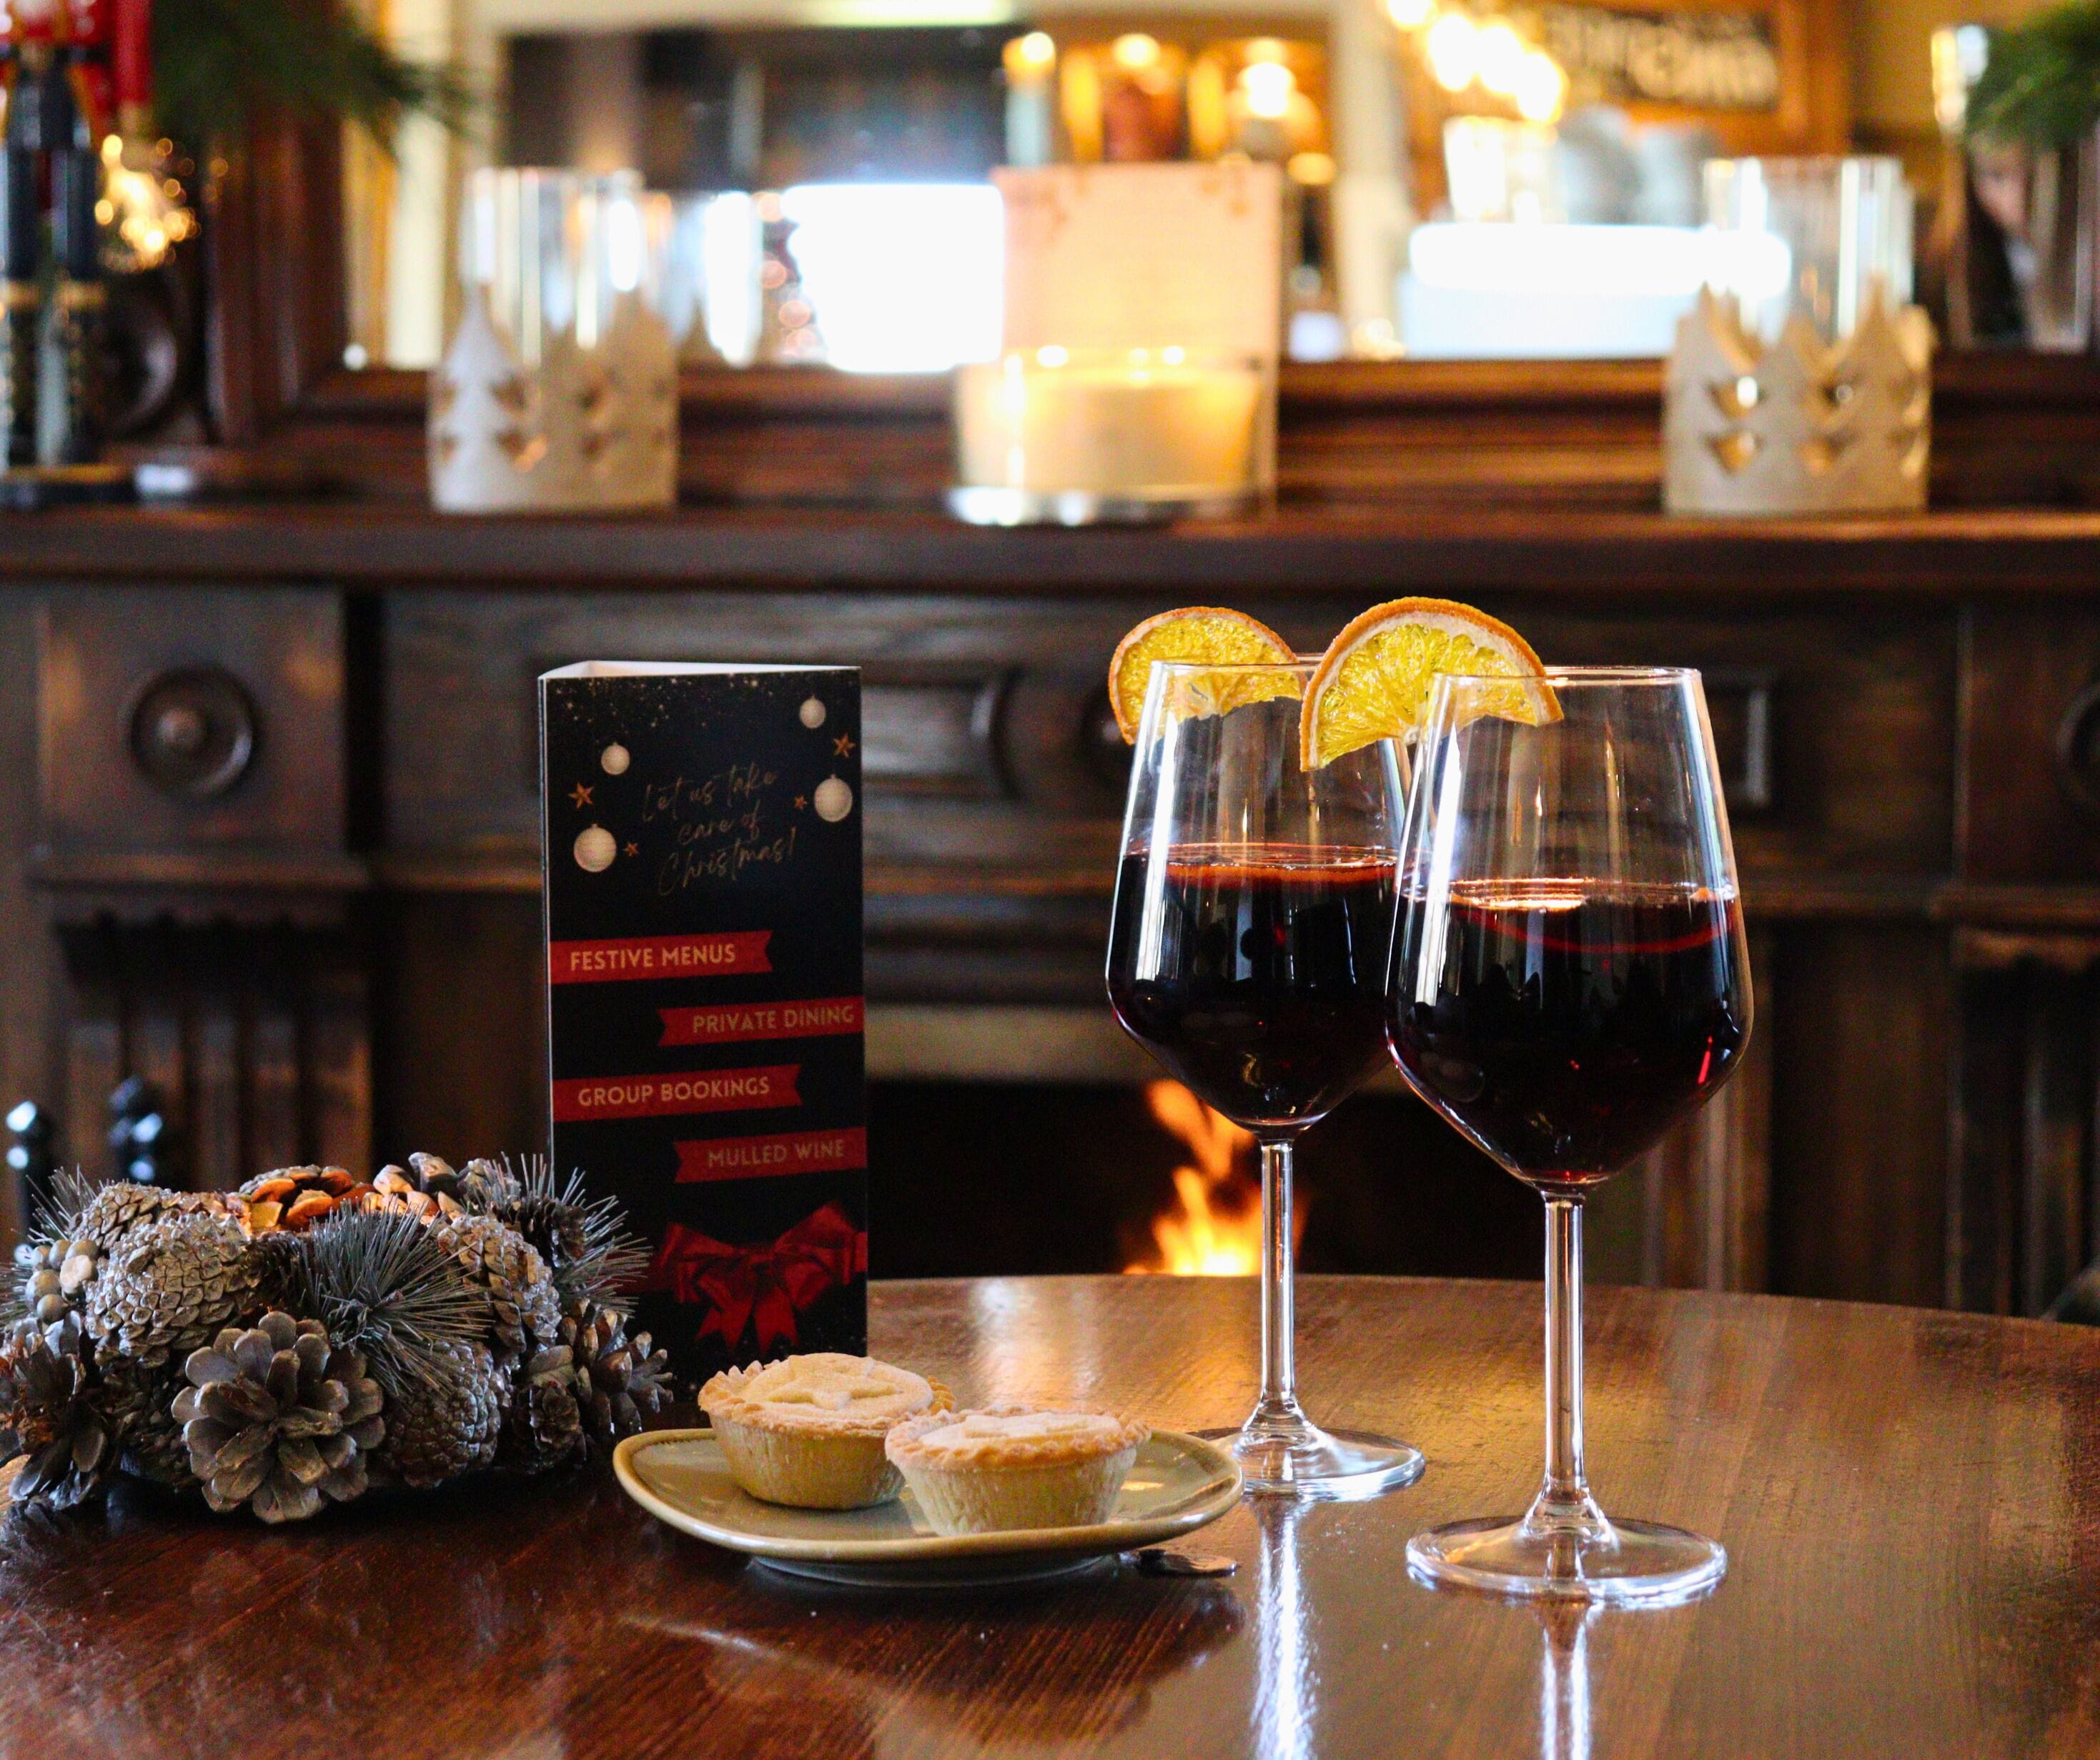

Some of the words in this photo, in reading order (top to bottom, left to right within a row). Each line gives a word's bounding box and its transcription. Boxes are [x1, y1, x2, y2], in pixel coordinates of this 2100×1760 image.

[740, 799, 766, 841] of
[570, 948, 653, 972] FESTIVE
[661, 943, 737, 967] MENUS
[692, 1008, 778, 1034] PRIVATE
[784, 1005, 856, 1028] DINING
[578, 1084, 653, 1108] GROUP
[660, 1075, 771, 1103] BOOKINGS
[706, 1143, 786, 1168] MULLED
[793, 1139, 846, 1161] WINE
